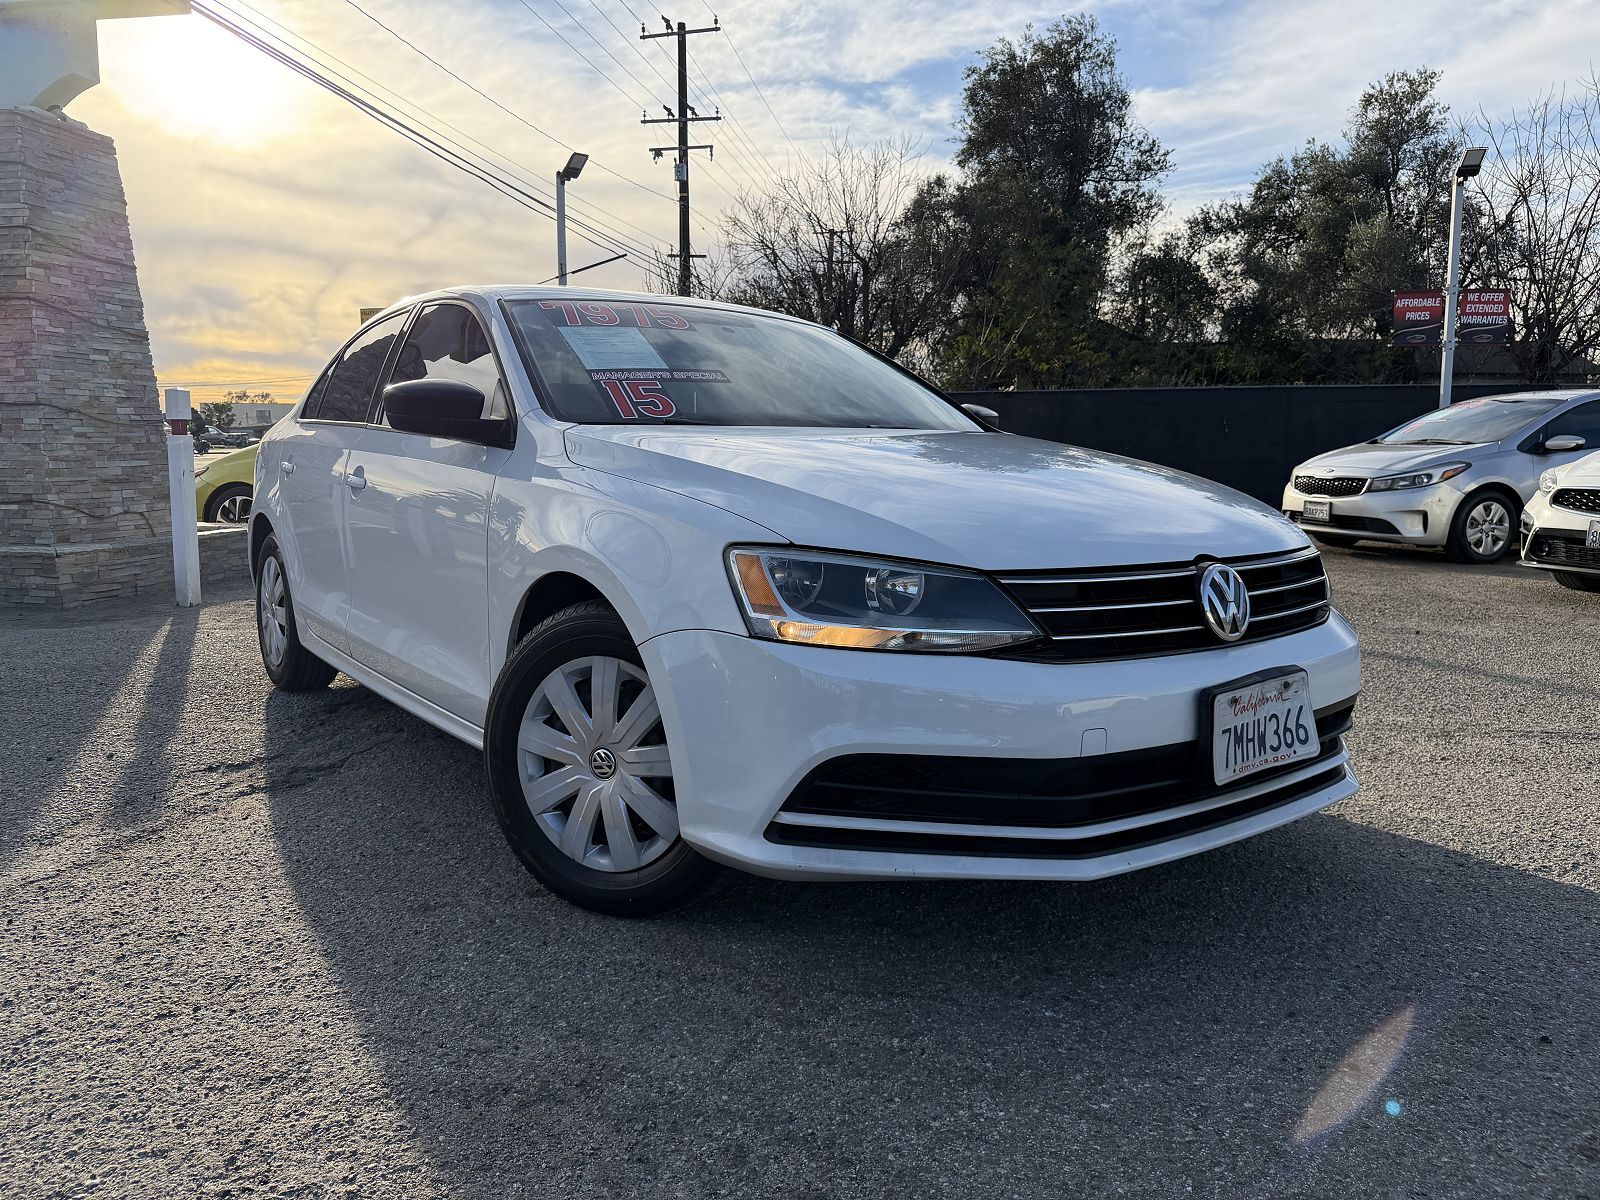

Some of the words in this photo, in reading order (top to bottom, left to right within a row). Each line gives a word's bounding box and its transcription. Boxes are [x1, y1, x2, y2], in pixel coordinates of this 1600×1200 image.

[1467, 293, 1479, 301] WE
[1480, 292, 1504, 302] OFFER
[1396, 298, 1441, 308] AFFORDABLE
[1466, 304, 1504, 313] EXTENDED
[538, 301, 690, 330] 7975
[1405, 311, 1430, 320] PRICES
[1461, 315, 1508, 324] WARRANTIES
[591, 371, 671, 380] MANAGER'S
[673, 371, 728, 380] SPECIAL
[600, 380, 676, 419] 15
[1232, 690, 1290, 717] California
[1221, 705, 1310, 770] 7MHW366
[1238, 752, 1292, 773] dmv.ca.gov
